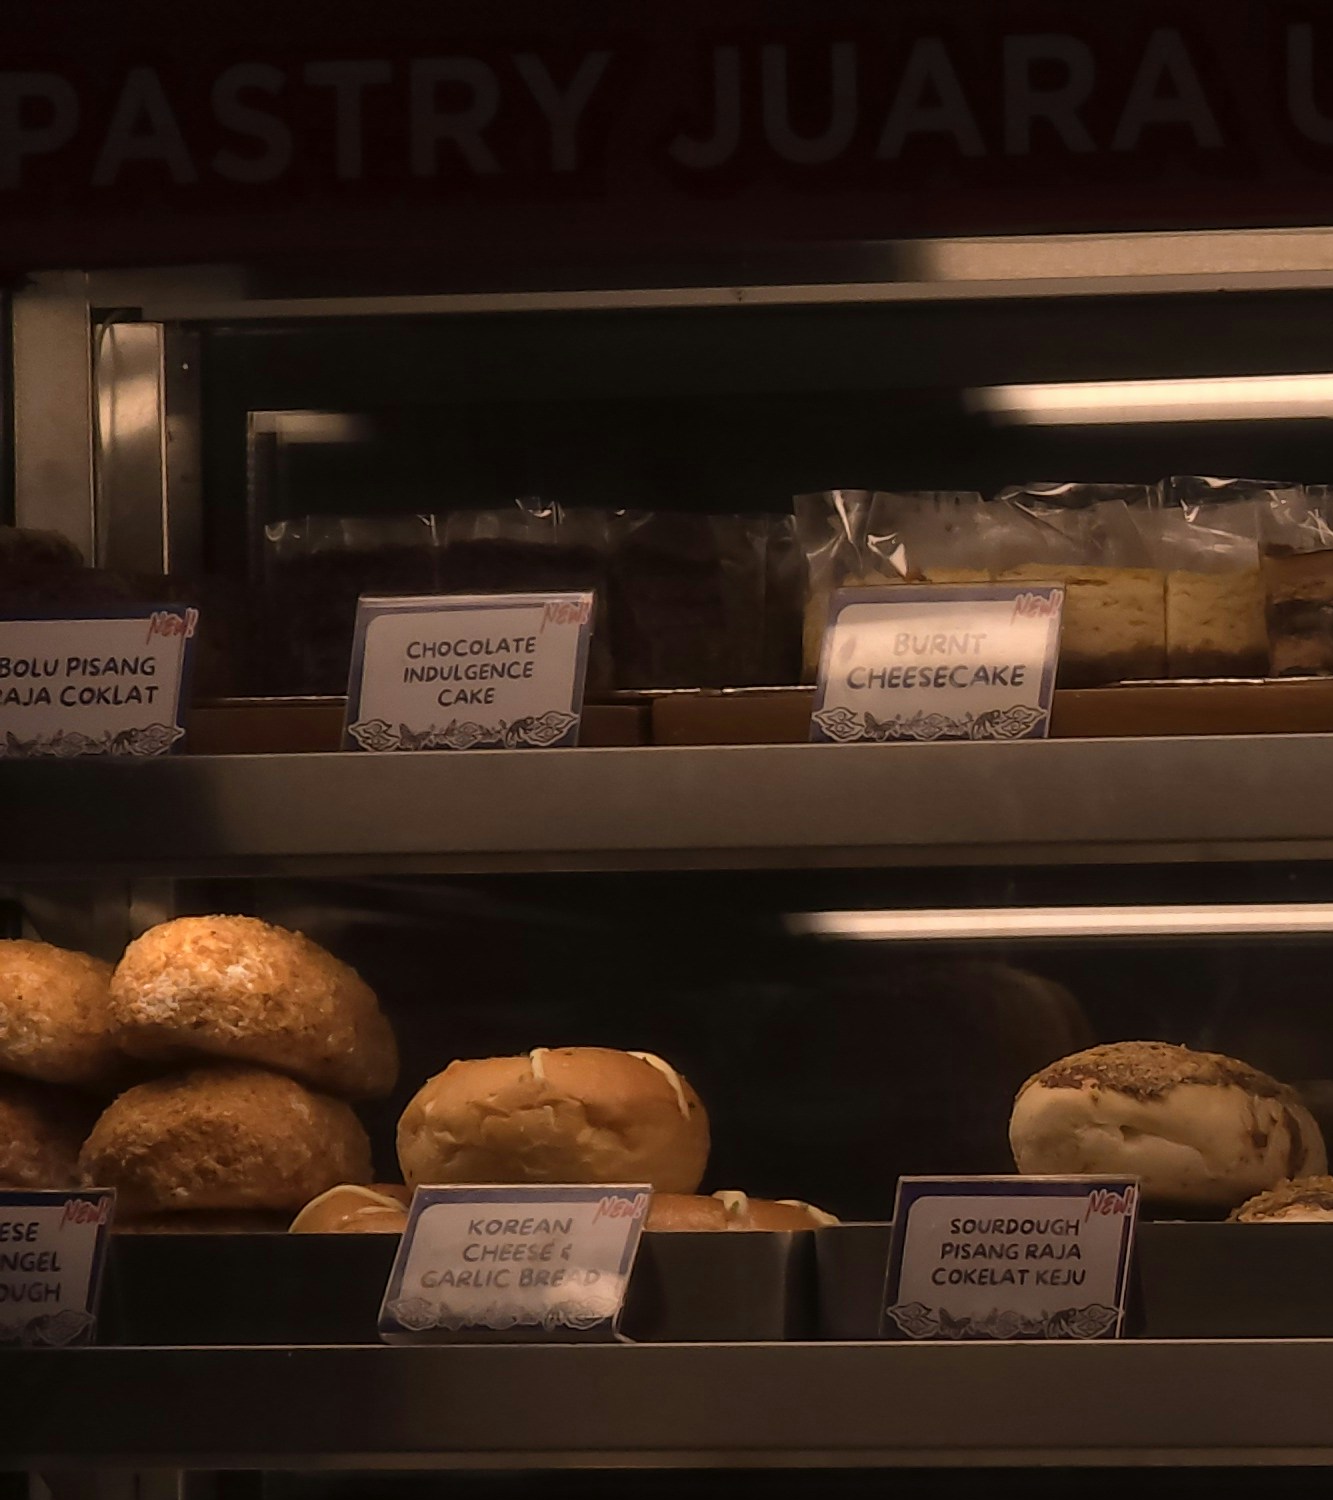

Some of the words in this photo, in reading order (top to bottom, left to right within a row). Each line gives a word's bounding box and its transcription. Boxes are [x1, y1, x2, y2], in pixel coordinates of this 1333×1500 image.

[0, 49, 616, 188] PASTRY
[669, 29, 1223, 168] JUARA
[406, 637, 536, 659] CHOCOLATE
[893, 633, 987, 656] BURNT
[0, 657, 58, 678] BOLU
[66, 656, 156, 677] PISANG
[403, 661, 535, 683] INDULGENCE
[847, 664, 1026, 690] CHEESECAKE
[60, 685, 158, 707] COKLAT
[437, 687, 495, 706] CAKE
[467, 1218, 573, 1236] KOREAN
[950, 1218, 1079, 1236] SOURDOUGH
[462, 1243, 552, 1263] CHEESE
[941, 1243, 1018, 1260] PISANG
[1026, 1243, 1081, 1260] RAJA
[420, 1269, 511, 1288] GARLIC
[519, 1268, 600, 1288] BREAD
[931, 1268, 1029, 1286] COKELAT
[1036, 1268, 1086, 1286] KEJU
